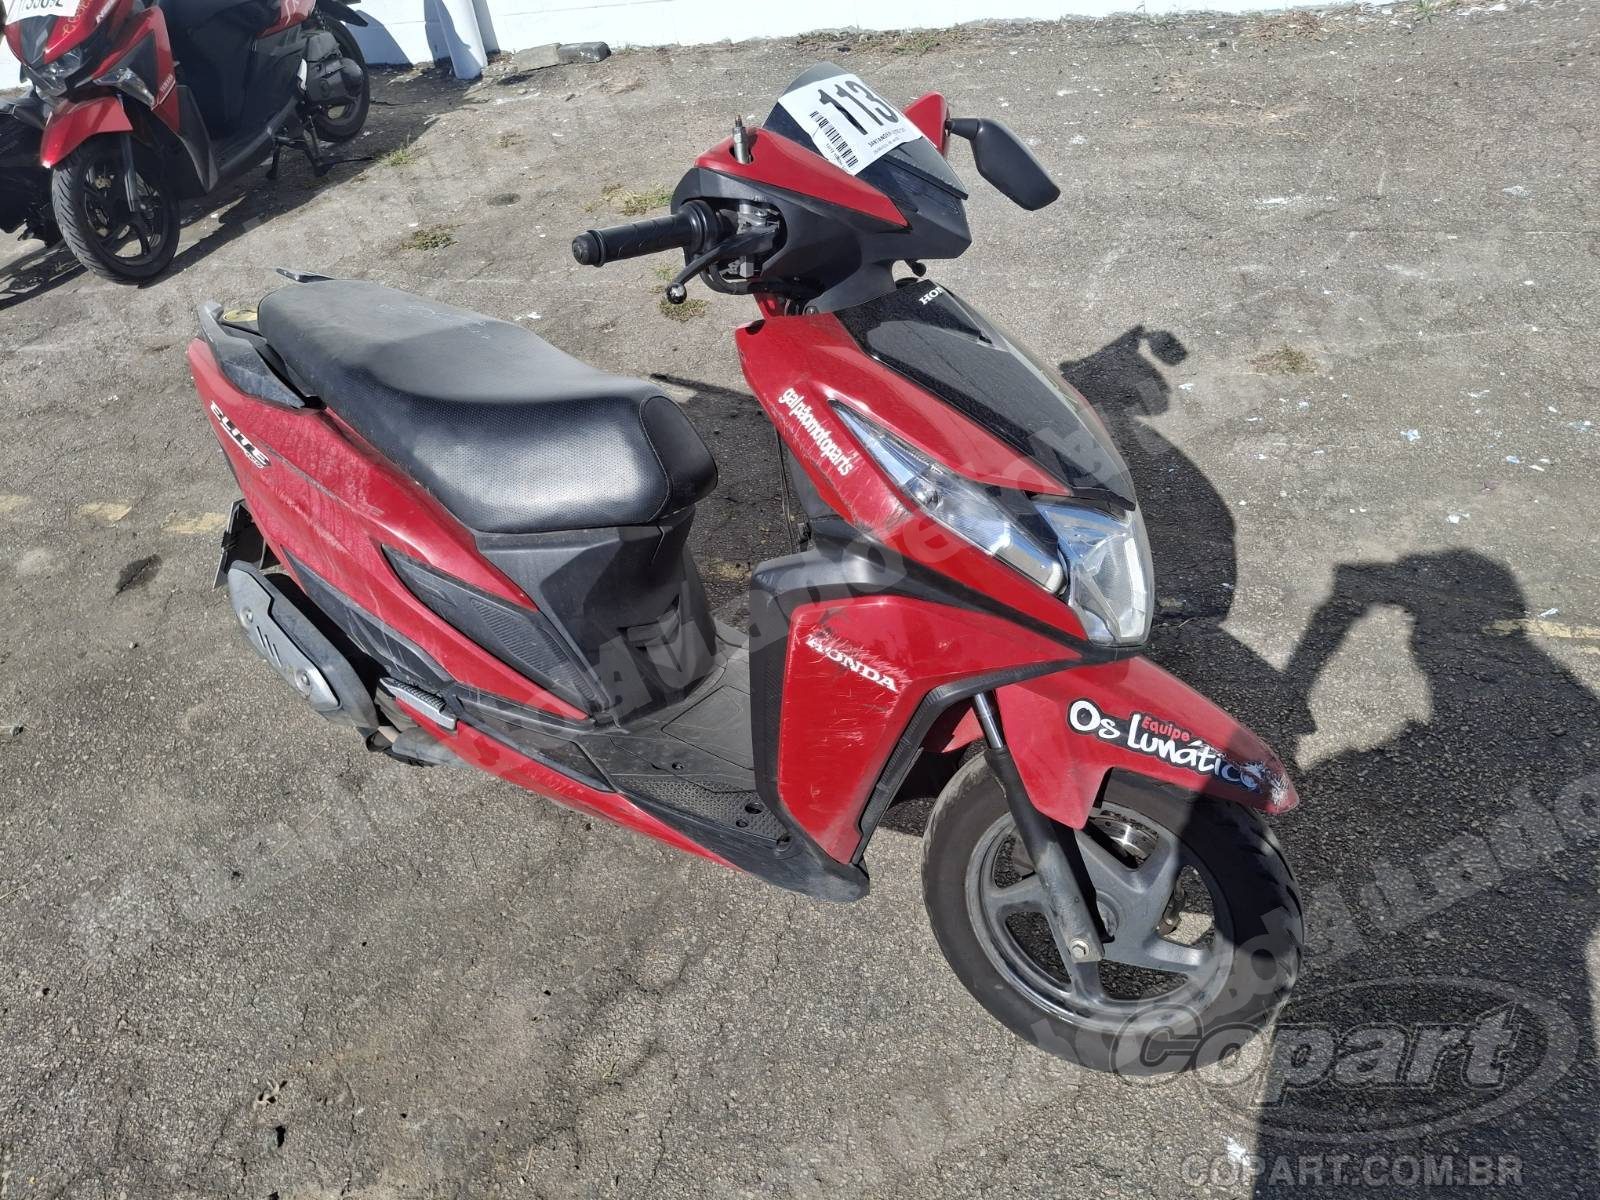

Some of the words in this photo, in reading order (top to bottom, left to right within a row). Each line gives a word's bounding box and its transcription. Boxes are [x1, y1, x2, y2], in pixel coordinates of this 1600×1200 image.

[817, 80, 900, 136] 113
[805, 634, 899, 692] HONDA
[1068, 700, 1122, 739] Os
[1126, 713, 1264, 792] Lunátic
[1141, 715, 1192, 742] Equipe
